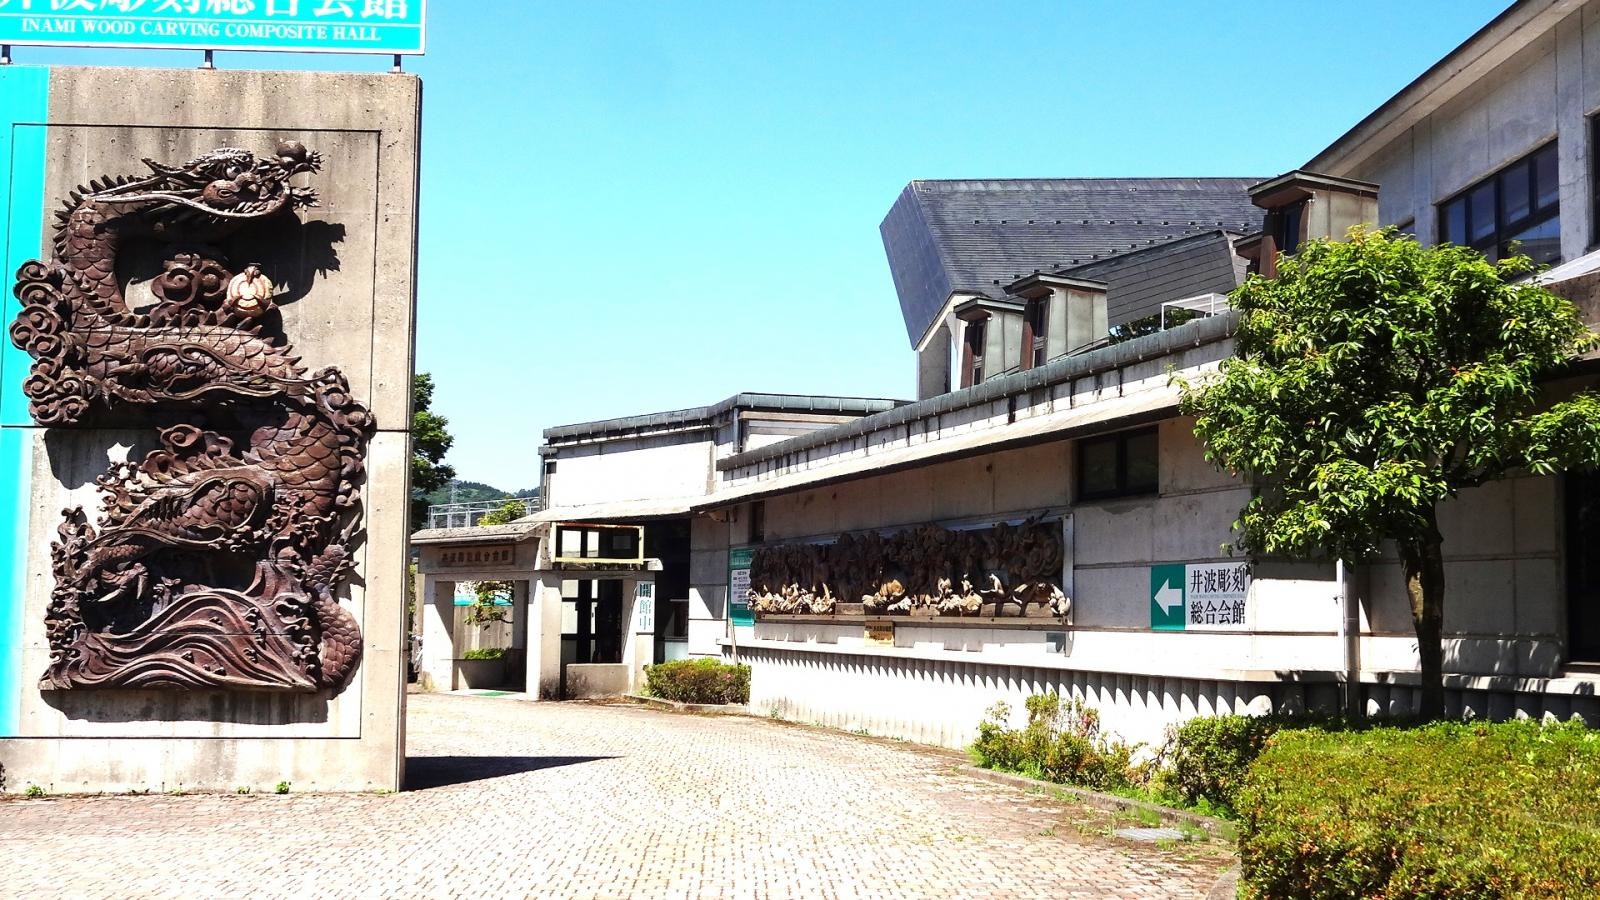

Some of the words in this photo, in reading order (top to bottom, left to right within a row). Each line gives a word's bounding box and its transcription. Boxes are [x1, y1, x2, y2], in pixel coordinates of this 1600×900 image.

[22, 17, 76, 33] INAMI
[82, 19, 136, 35] WOOD
[140, 21, 220, 37] CARVING
[225, 23, 328, 40] COMPOSITE
[333, 26, 382, 41] HALL
[1190, 567, 1246, 593] 井波彫刻
[1190, 599, 1246, 625] 総合会館
